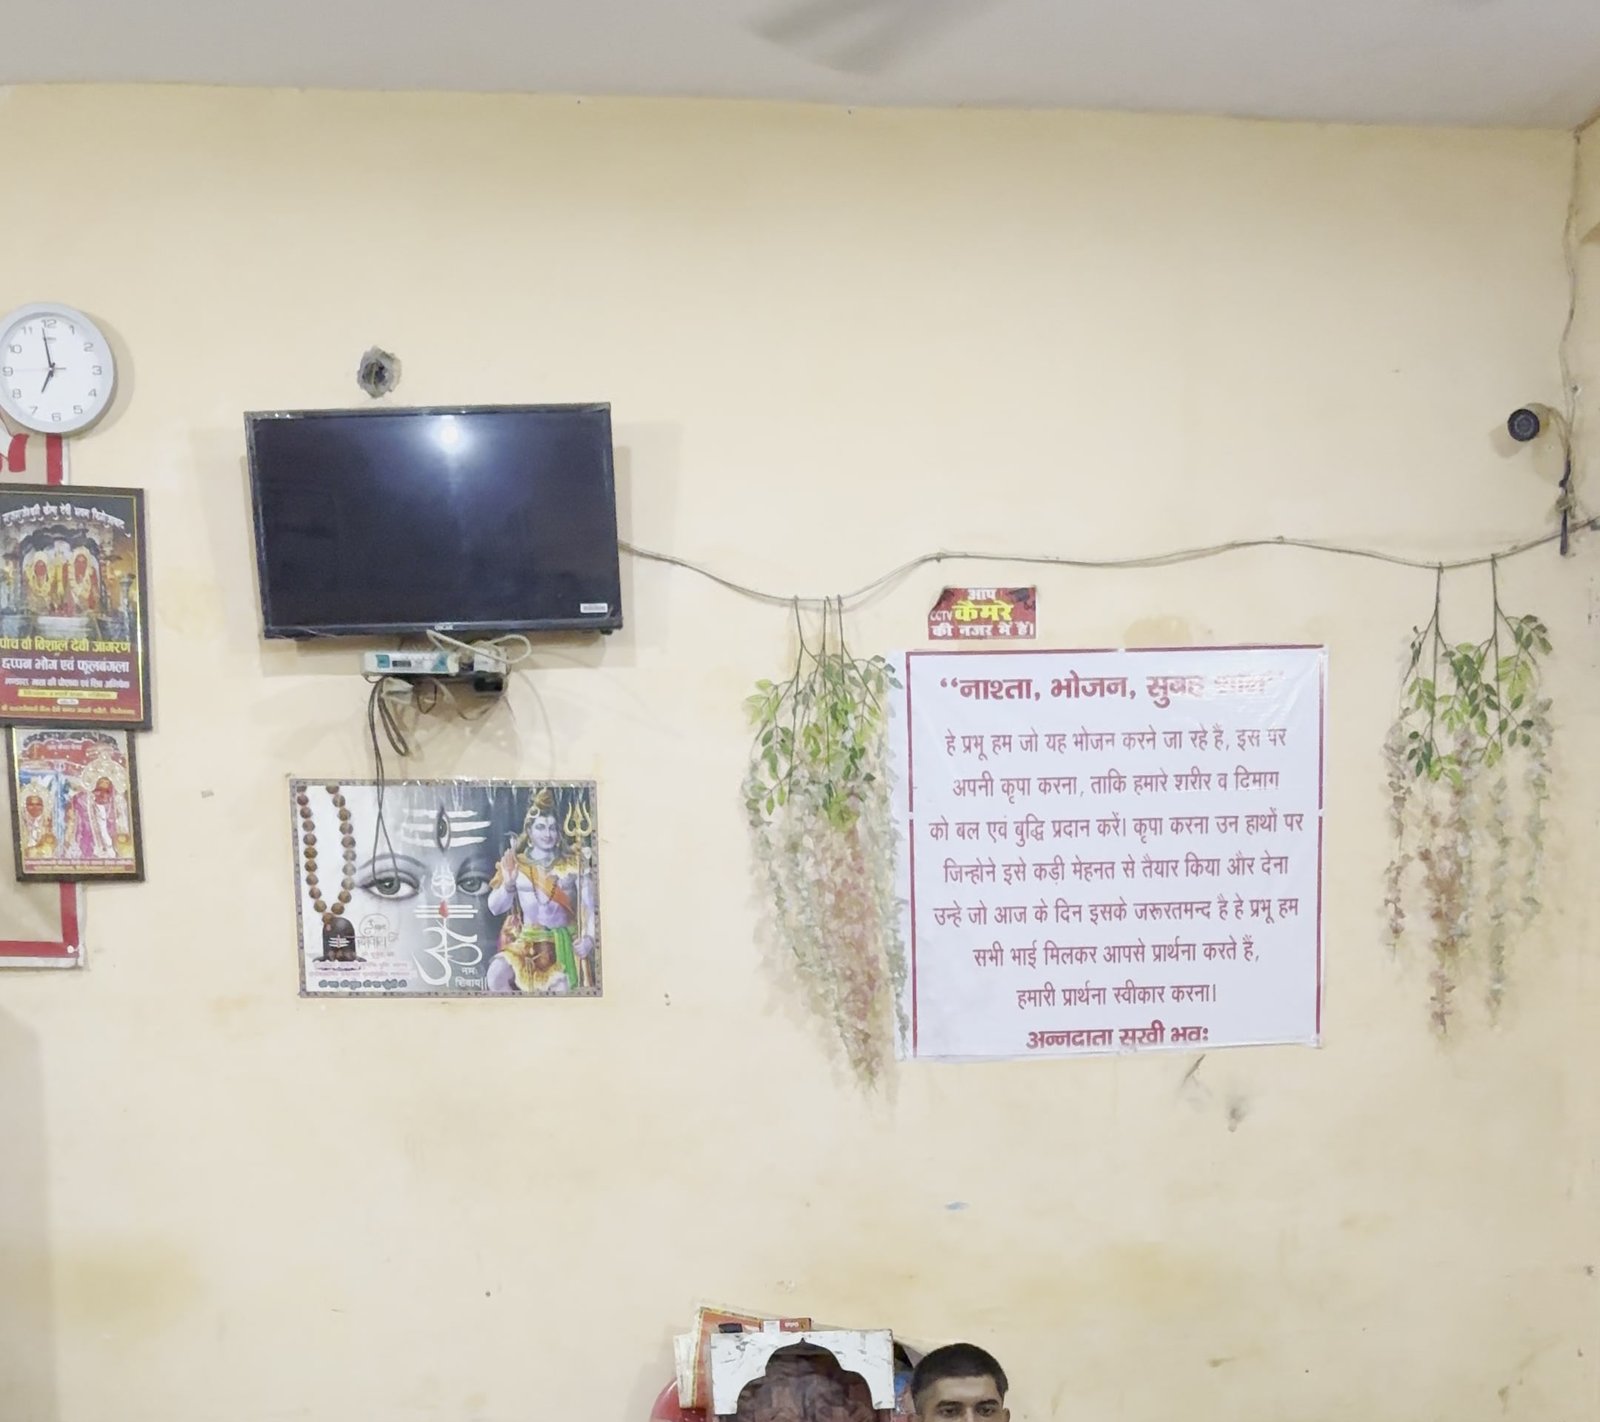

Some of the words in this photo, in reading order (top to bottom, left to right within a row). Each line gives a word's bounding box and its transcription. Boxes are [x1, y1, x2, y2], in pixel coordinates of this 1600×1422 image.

[968, 589, 997, 600] आप
[930, 610, 952, 621] CCTV
[952, 600, 1014, 621] कैमरे
[930, 622, 954, 637] की
[959, 625, 993, 637] नजर
[998, 621, 1012, 636] में
[35, 656, 57, 670] भोग
[60, 656, 75, 671] एवं
[1050, 670, 1136, 700] भोजन,
[945, 728, 956, 756] हे
[991, 734, 1012, 755] हम
[1018, 727, 1039, 752] जो
[1044, 733, 1067, 754] यह
[1072, 726, 1115, 751] भोजन
[1121, 725, 1157, 750] करने
[1162, 731, 1183, 750] जा
[1188, 725, 1208, 751] रहे
[1235, 729, 1261, 751] इस
[952, 770, 994, 797] अपनी
[1000, 778, 1031, 804] कृपा
[1090, 768, 1127, 794] ताकि
[1133, 767, 1168, 795] हमारे
[1173, 766, 1212, 791] शरीर
[1217, 773, 1228, 791] व
[928, 815, 949, 841] को
[955, 822, 980, 841] बल
[986, 815, 1008, 843] एवं
[1013, 813, 1046, 848] बुद्धि
[1051, 819, 1090, 838] प्रदान
[1132, 817, 1163, 844] कृपा
[1169, 816, 1209, 835] करना
[1215, 815, 1239, 834] उन
[1245, 807, 1277, 835] हाथों
[1283, 813, 1304, 832] पर
[1002, 857, 1026, 885] इसे
[1032, 855, 1065, 885] कड़ी
[1071, 855, 1116, 882] मेहनत
[1121, 854, 1135, 879] से
[1141, 853, 1179, 878] तैयार
[1184, 851, 1220, 877] किया
[1227, 851, 1255, 876] और
[1260, 850, 1288, 875] देना
[933, 900, 962, 928] उन्हे
[967, 900, 987, 925] जो
[994, 905, 1027, 924] आज
[1033, 898, 1048, 924] के
[1054, 898, 1082, 923] दिन
[1088, 896, 1127, 926] इसके
[1133, 901, 1212, 921] जरूरतमन्द
[1233, 892, 1243, 920] हे
[1277, 898, 1299, 918] हम
[972, 941, 1004, 967] सभी
[1010, 939, 1037, 969] भाई
[1043, 940, 1098, 965] मिलकर
[1103, 937, 1146, 963] आपसे
[1151, 936, 1196, 962] प्रार्थना
[1202, 935, 1237, 960] करते
[1016, 981, 1056, 1010] हमारी
[1062, 980, 1107, 1006] प्रार्थना
[1112, 979, 1166, 1004] स्वीकार
[1170, 984, 1217, 1003] करना।
[1026, 1029, 1114, 1049] अन्नदाता
